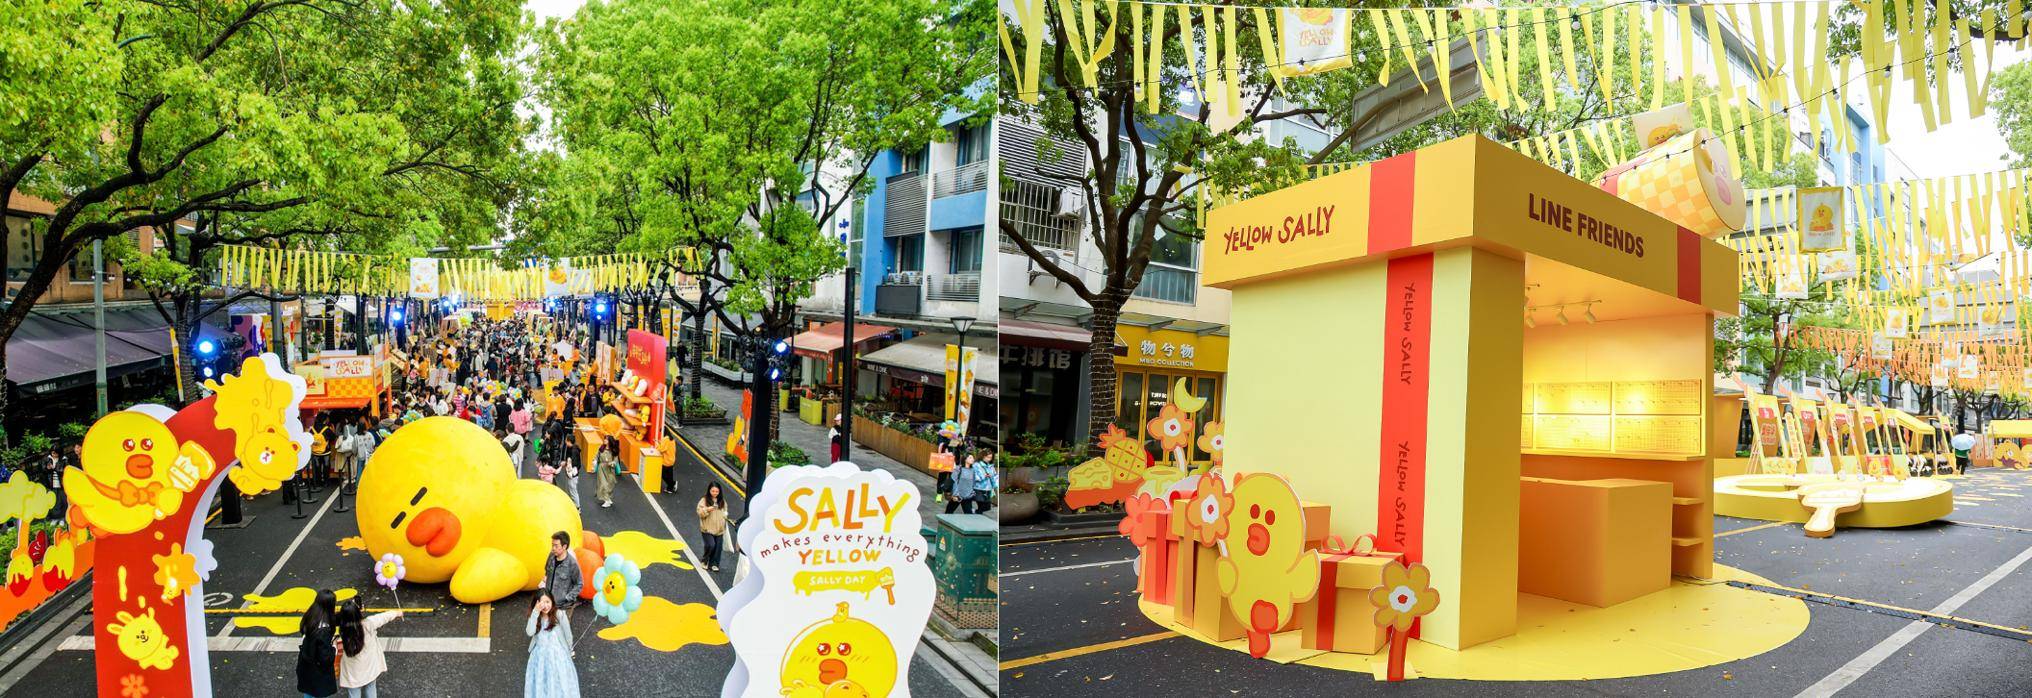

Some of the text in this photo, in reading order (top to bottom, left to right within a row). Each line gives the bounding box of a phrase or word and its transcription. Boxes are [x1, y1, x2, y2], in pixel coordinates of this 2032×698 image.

[1223, 204, 1335, 255] YELLOW SALLY
[1528, 192, 1644, 258] LINE FRIENDS
[1400, 282, 1416, 385] YELLOW SALLY
[773, 482, 911, 534] SALLY
[1394, 441, 1410, 547] YELLOW SALLY
[760, 533, 920, 563] makes everything
[798, 549, 881, 565] YELLOW
[809, 575, 866, 586] SALLY DAY
